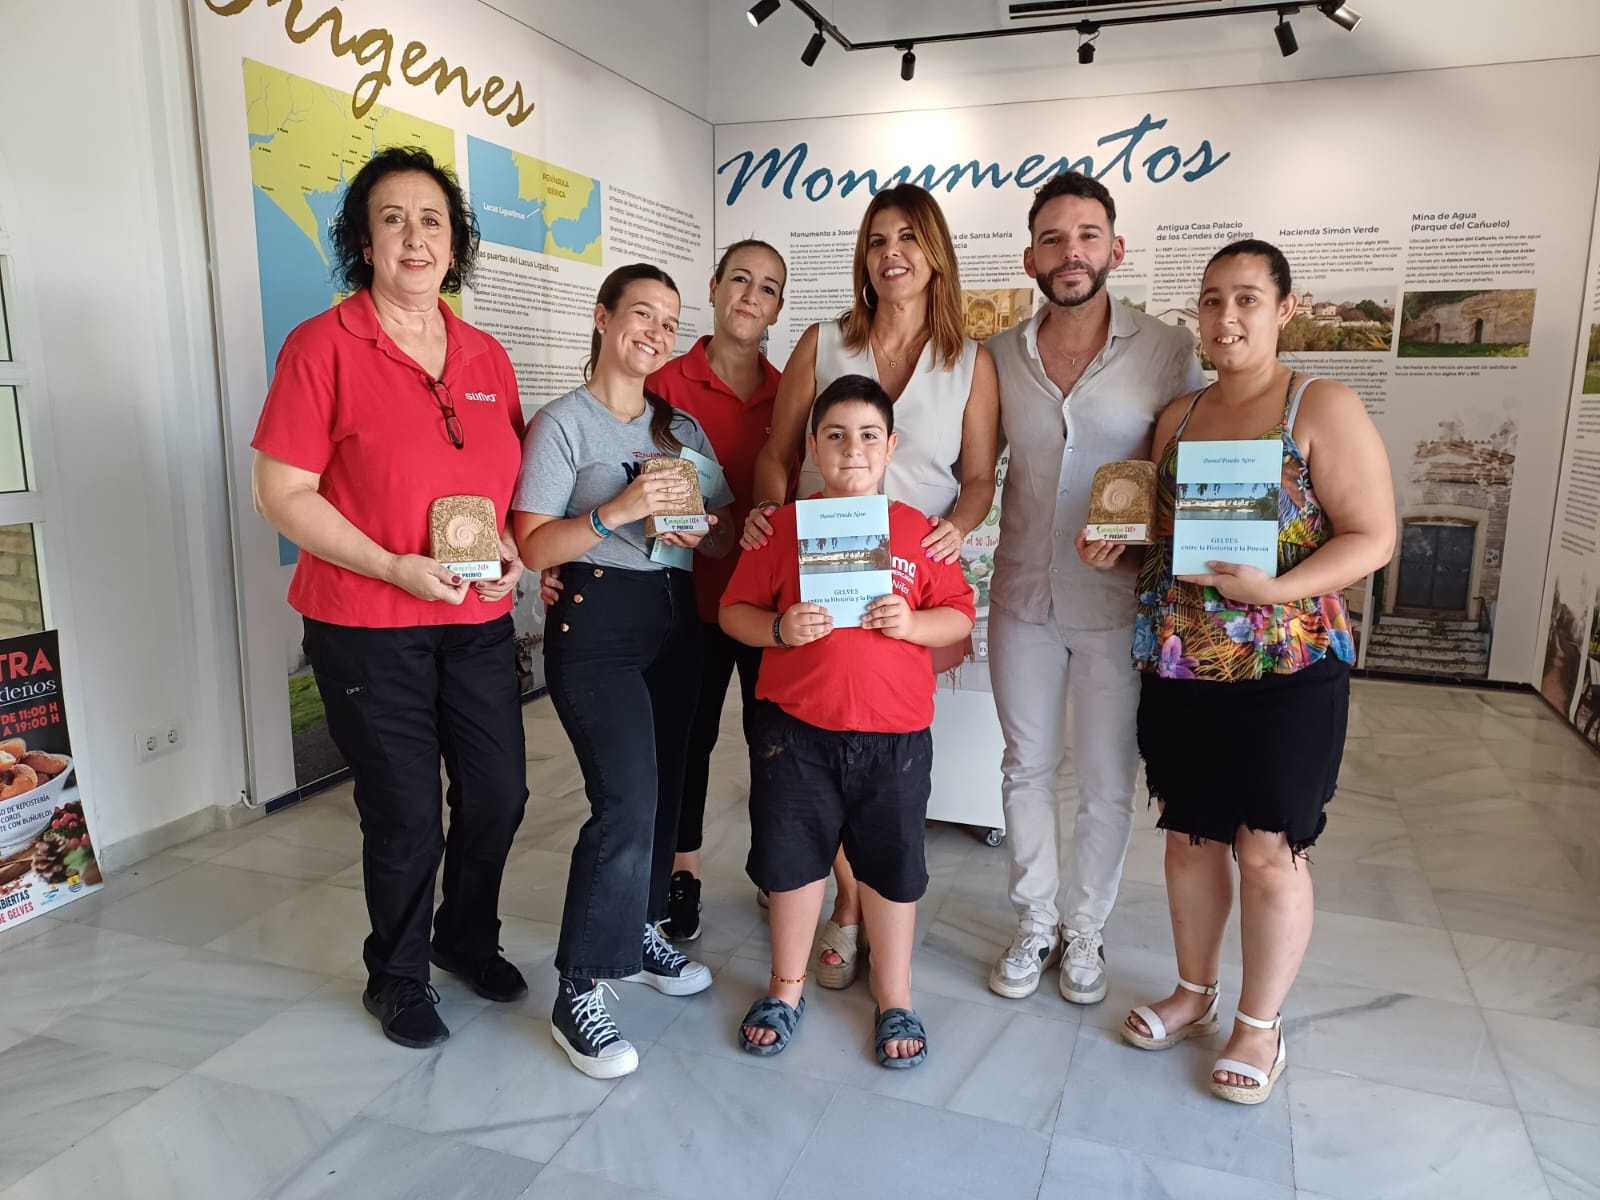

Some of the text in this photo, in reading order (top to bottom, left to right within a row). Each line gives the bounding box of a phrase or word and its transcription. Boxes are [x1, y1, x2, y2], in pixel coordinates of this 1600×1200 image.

[1452, 212, 1477, 222] Agua
[1322, 226, 1350, 234] Simón
[1354, 226, 1379, 234] Verde
[1411, 220, 1510, 232] (Parque del Cañuelo)
[1226, 231, 1254, 239] Gelves
[519, 258, 533, 267] Lacus
[1, 702, 58, 725] DE 11:00 H
[3, 713, 59, 736] A 19:00 H
[6, 806, 15, 814] DE
[16, 794, 50, 810] REPOSTERÍA
[8, 820, 21, 830] CON
[22, 809, 52, 824] BUÑUELOS
[8, 902, 34, 920] GELVES
